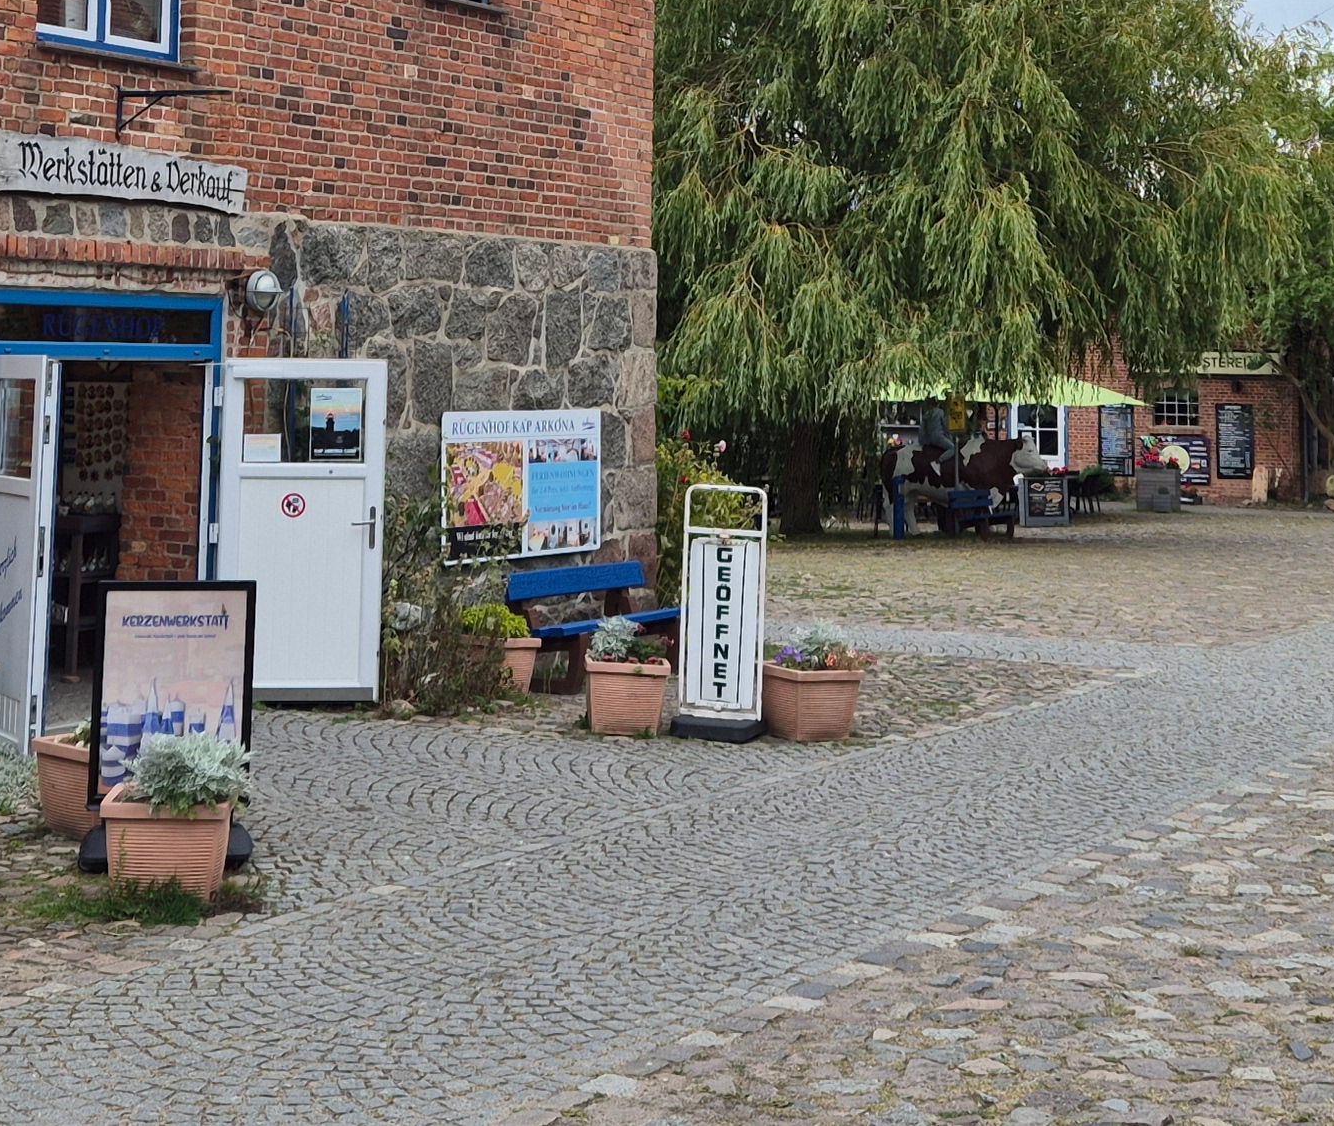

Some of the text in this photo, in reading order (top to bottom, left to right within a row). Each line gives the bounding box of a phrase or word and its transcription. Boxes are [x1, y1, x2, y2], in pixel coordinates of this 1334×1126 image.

[150, 171, 163, 193] &
[1201, 356, 1247, 370] STEREI
[512, 418, 533, 433] KAP
[534, 417, 575, 433] ARKONA
[121, 613, 229, 630] KERZENWERKSTATT
[713, 547, 733, 699] GEÖFFNET
